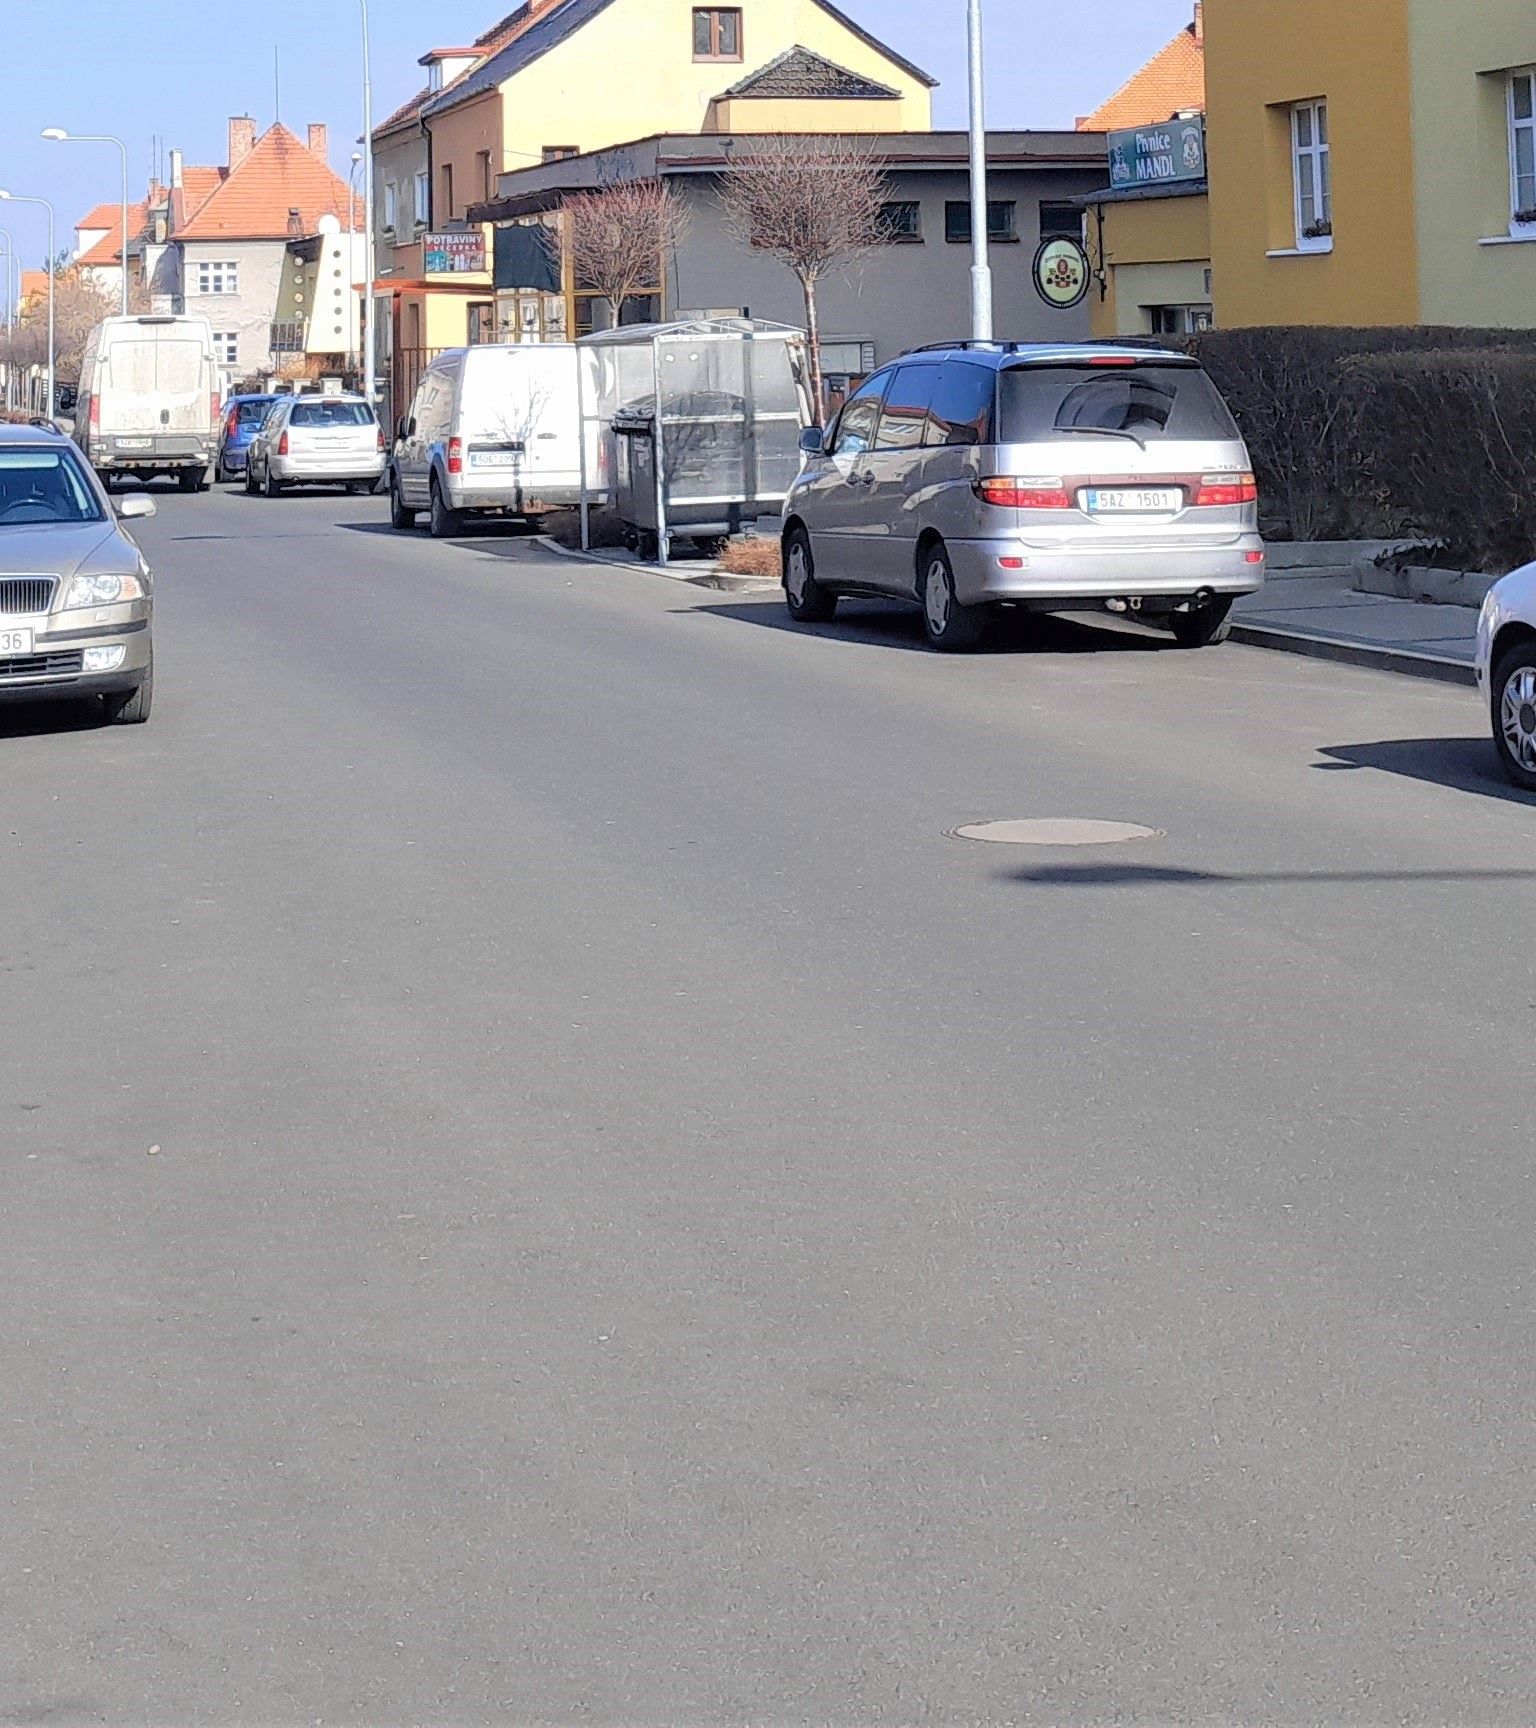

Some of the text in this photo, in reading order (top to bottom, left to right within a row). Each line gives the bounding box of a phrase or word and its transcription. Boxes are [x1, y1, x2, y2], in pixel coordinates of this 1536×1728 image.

[1135, 130, 1171, 153] Pivnice
[1135, 155, 1176, 180] MANDL
[426, 234, 482, 244] POTRAVINY
[1136, 492, 1168, 506] 1501
